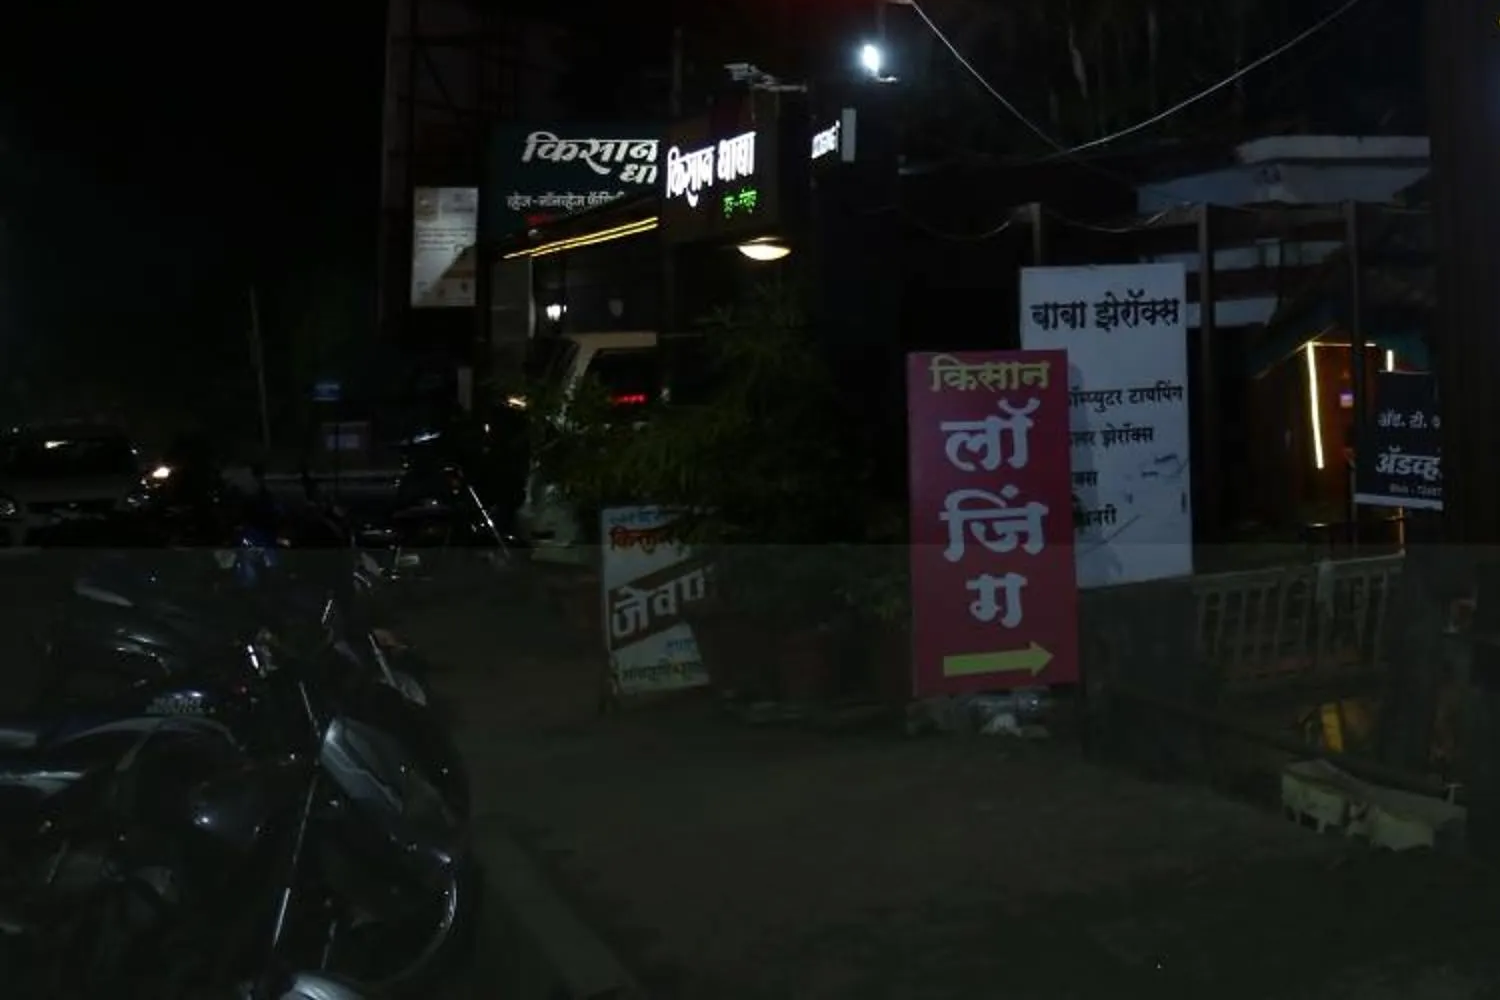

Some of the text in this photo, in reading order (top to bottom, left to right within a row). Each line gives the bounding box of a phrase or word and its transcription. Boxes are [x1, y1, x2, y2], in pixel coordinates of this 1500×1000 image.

[521, 131, 661, 175] किसान
[618, 162, 659, 185] धा
[929, 353, 1052, 392] किसान
